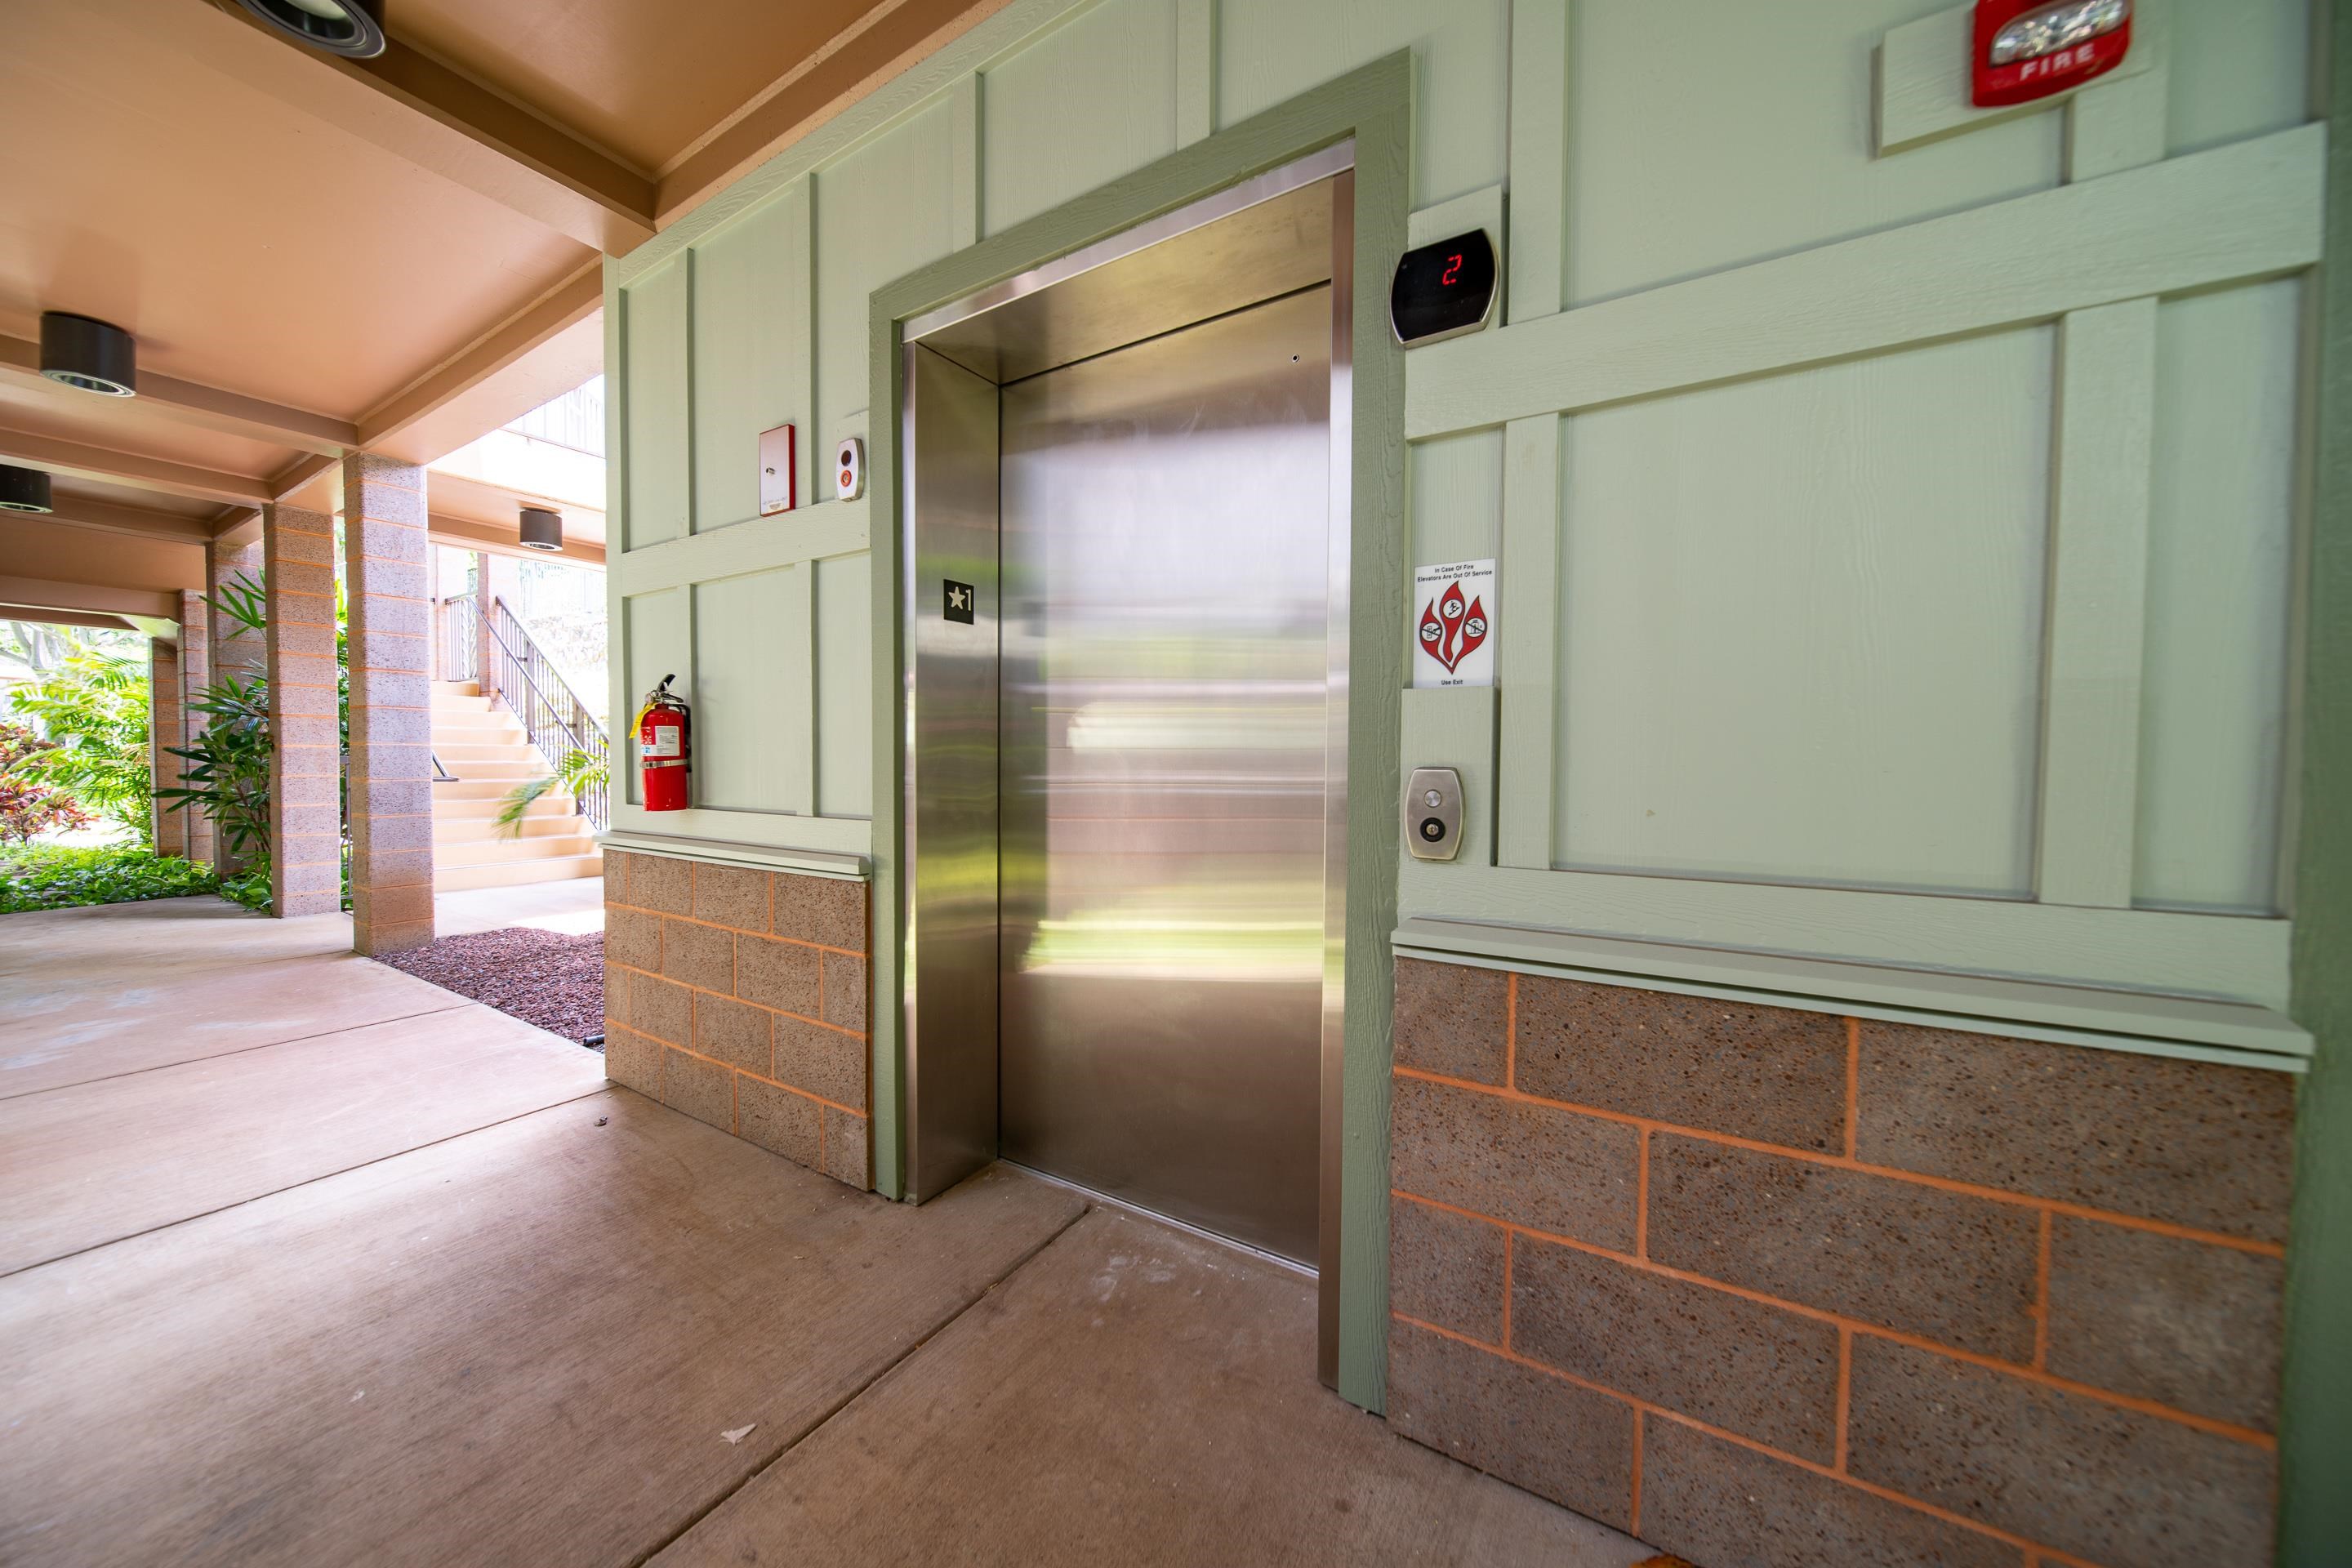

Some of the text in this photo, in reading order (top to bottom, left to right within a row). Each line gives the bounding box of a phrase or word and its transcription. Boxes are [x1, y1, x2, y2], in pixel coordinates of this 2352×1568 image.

[2020, 43, 2095, 81] FIRE
[1442, 254, 1462, 285] 2
[965, 589, 972, 612] 1
